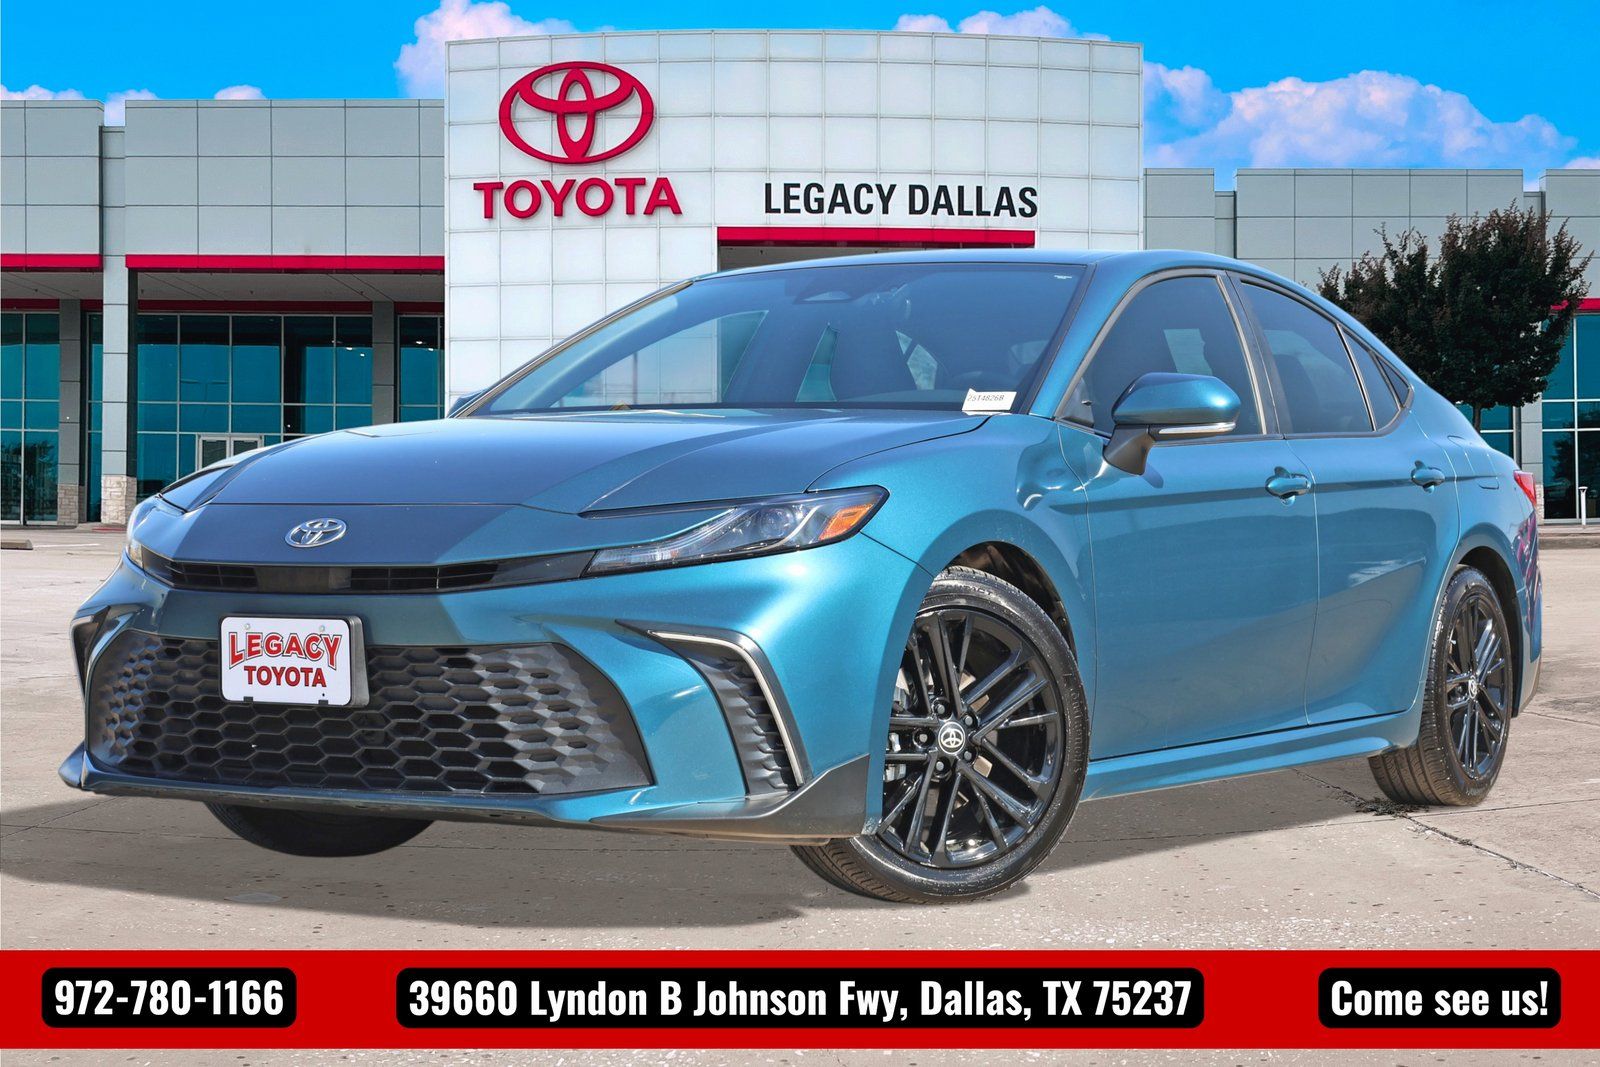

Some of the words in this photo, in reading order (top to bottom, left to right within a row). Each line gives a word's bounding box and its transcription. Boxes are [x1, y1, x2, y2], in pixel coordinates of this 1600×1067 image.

[473, 176, 682, 220] TOYOTA
[765, 182, 897, 215] LEGACY
[908, 184, 1038, 218] DALLAS
[228, 632, 342, 670] LEGACY
[243, 665, 327, 687] TOYOTA
